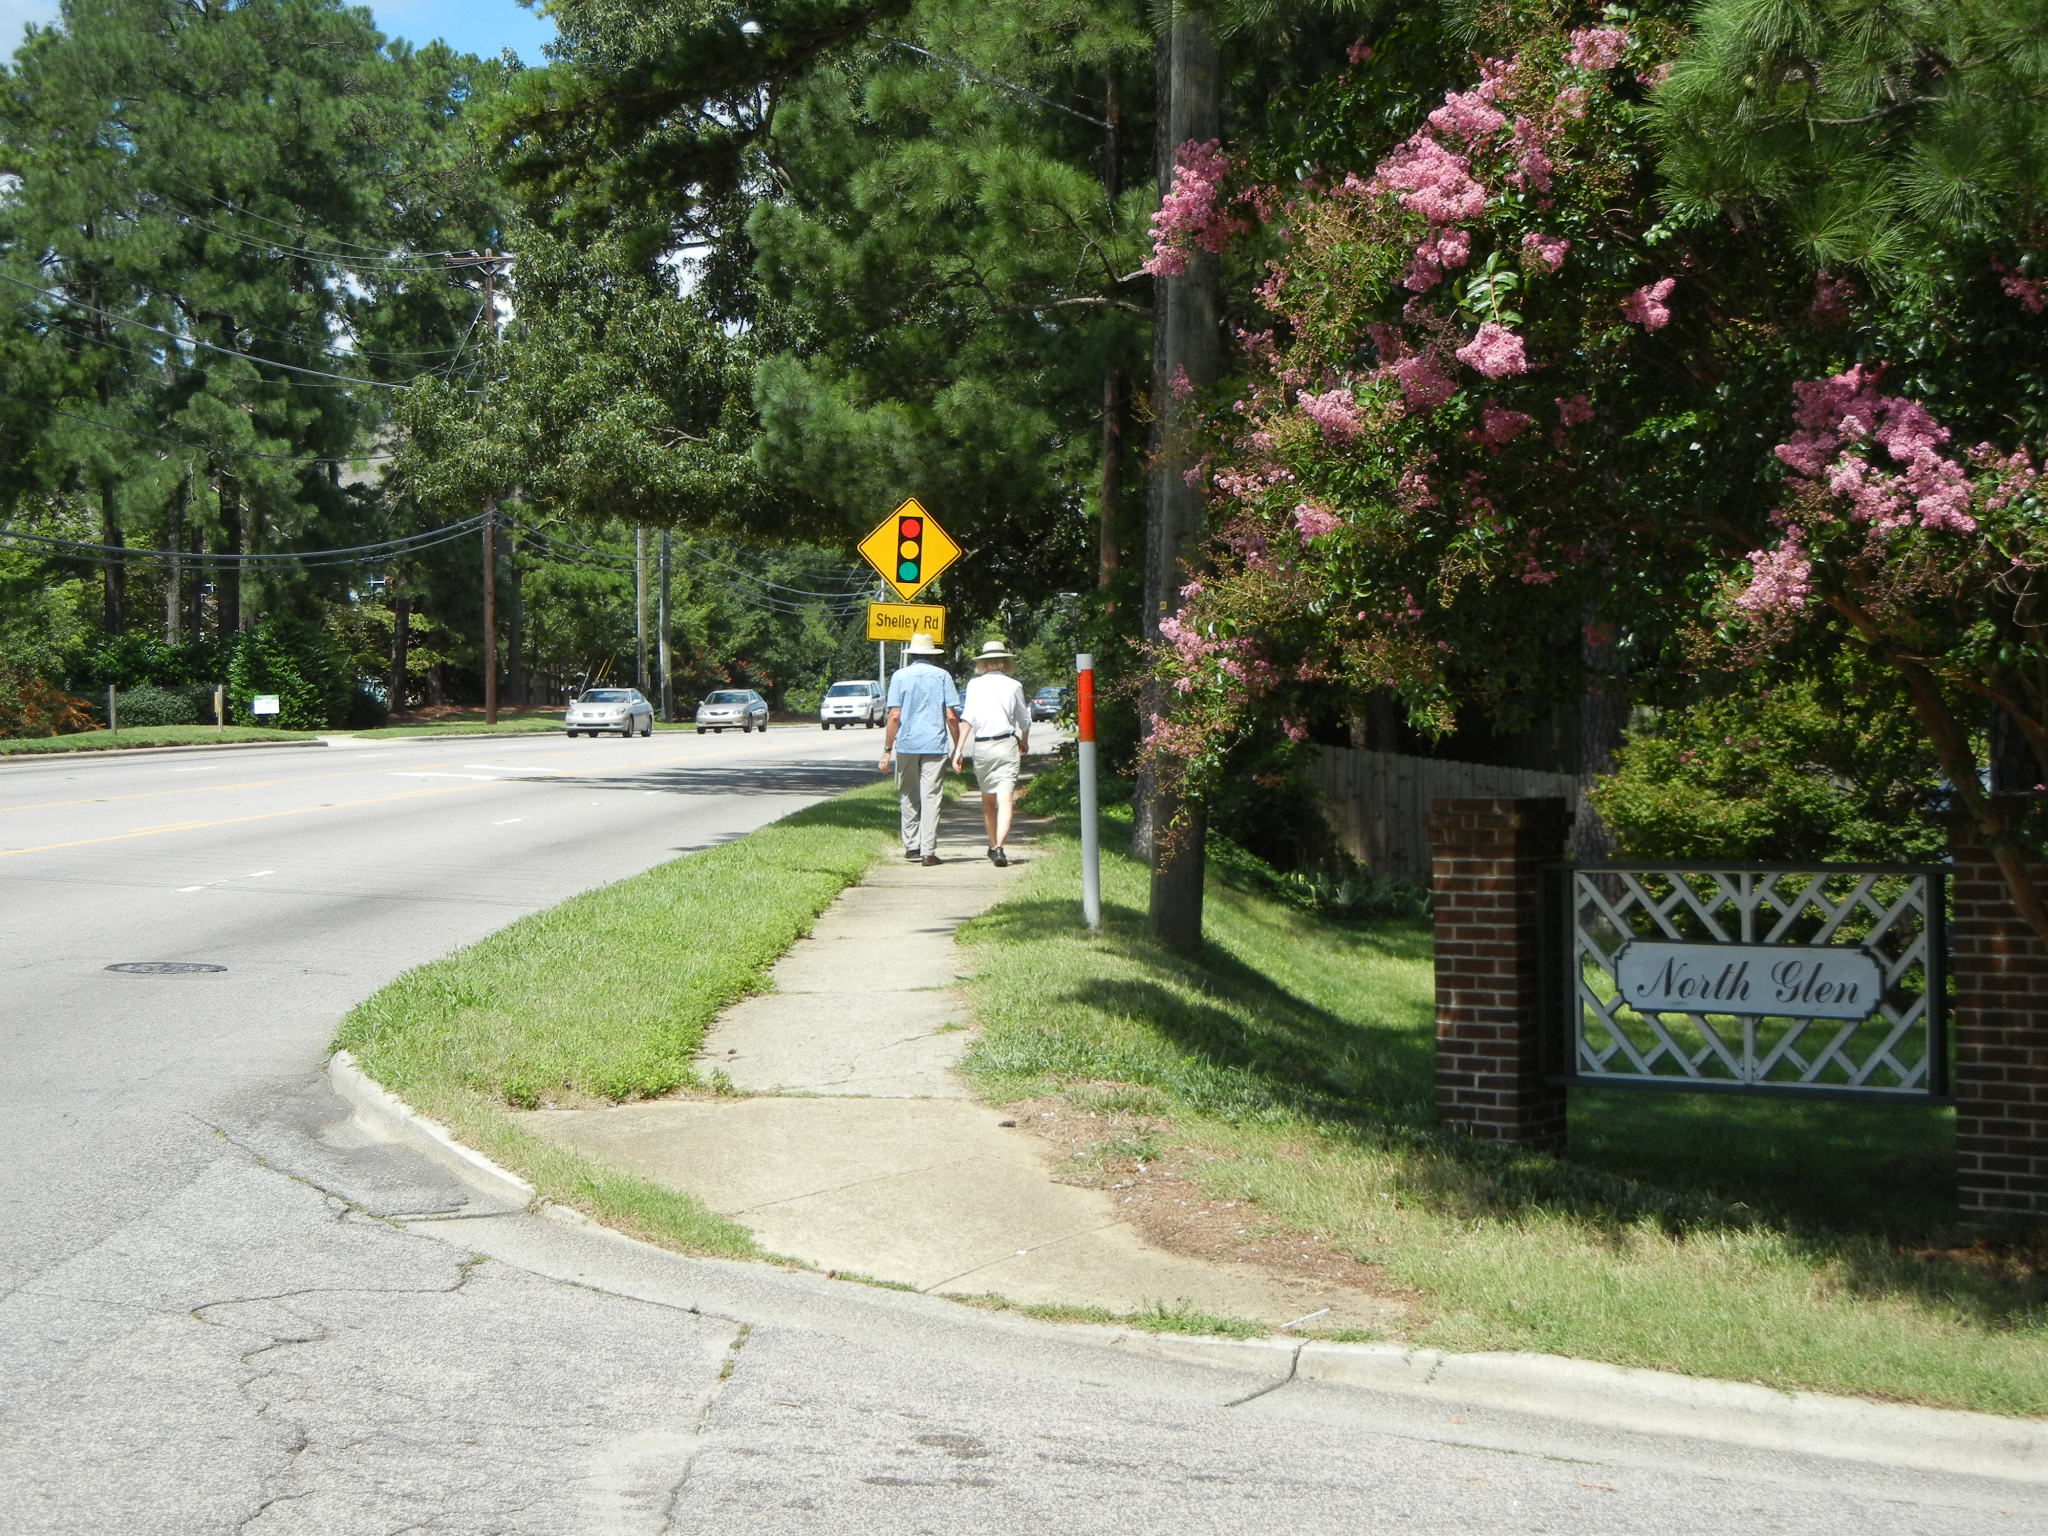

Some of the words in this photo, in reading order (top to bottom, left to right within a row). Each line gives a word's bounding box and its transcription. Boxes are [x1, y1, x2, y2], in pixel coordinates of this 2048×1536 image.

[876, 613, 919, 631] Shelley
[924, 615, 939, 630] Rd
[1637, 957, 1750, 1001] North
[1771, 960, 1860, 1004] Glen
